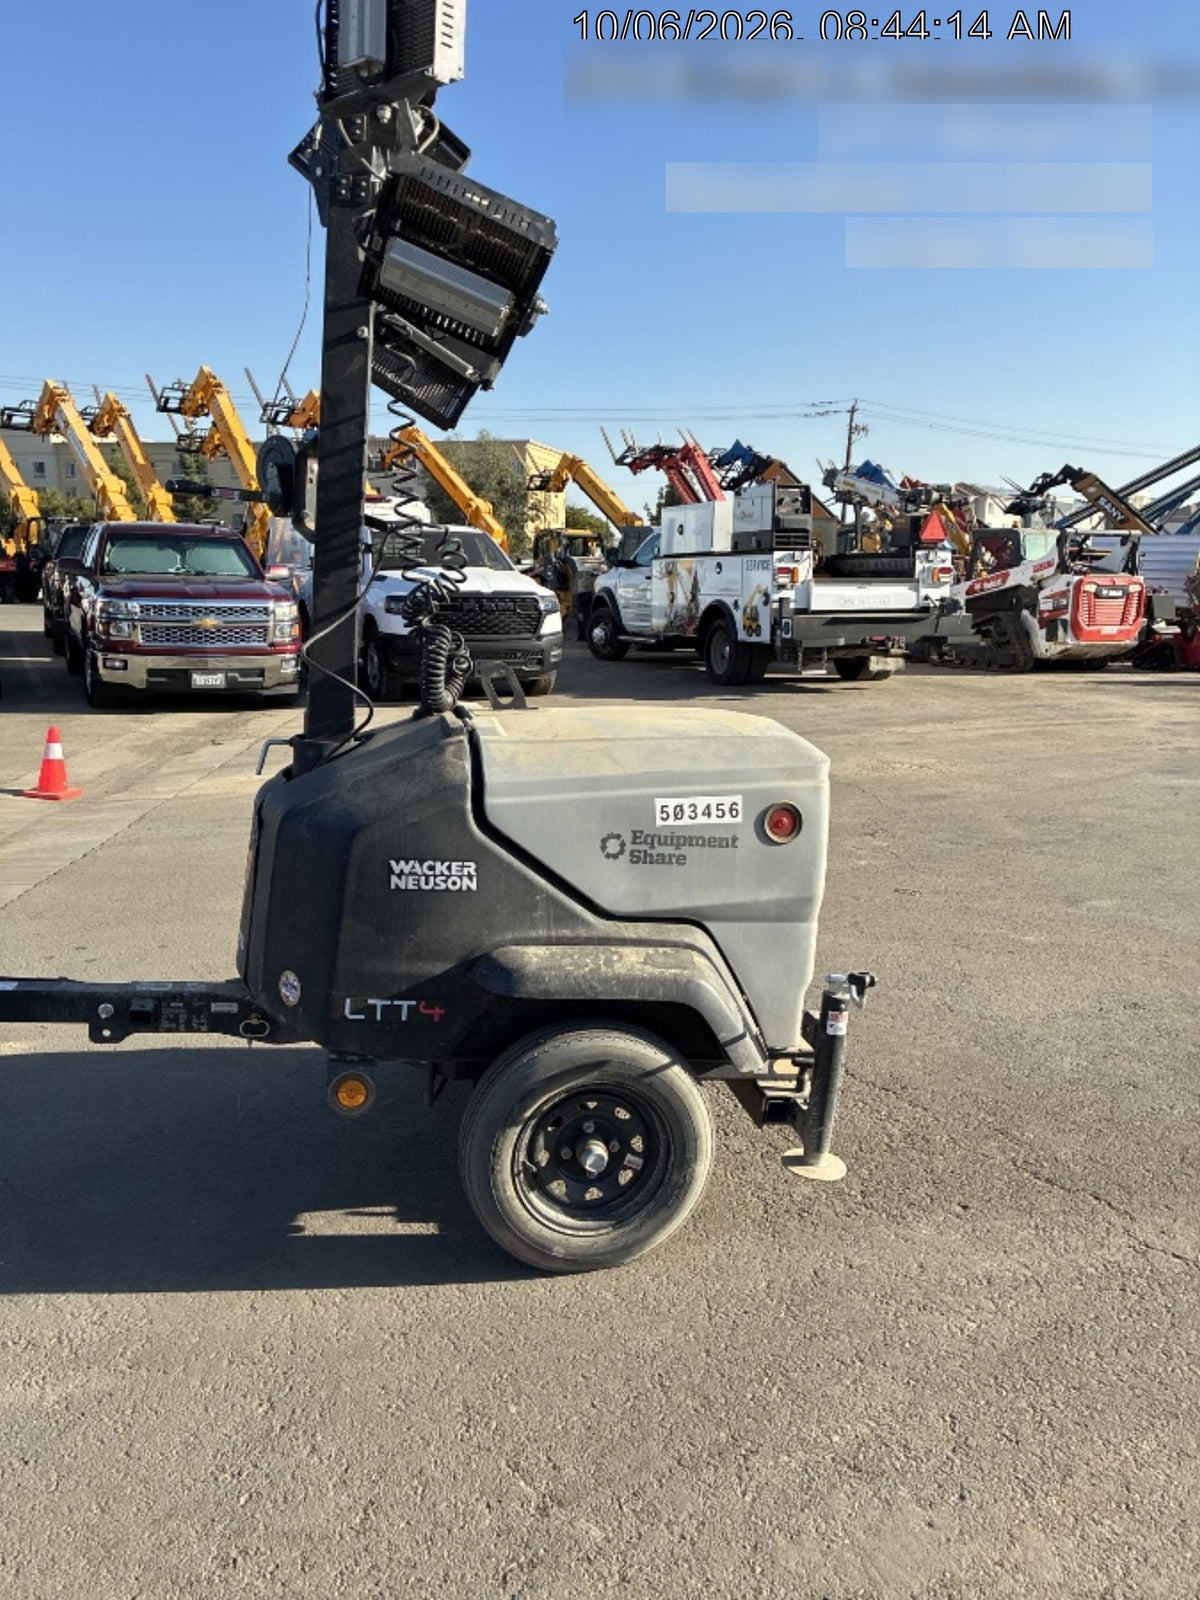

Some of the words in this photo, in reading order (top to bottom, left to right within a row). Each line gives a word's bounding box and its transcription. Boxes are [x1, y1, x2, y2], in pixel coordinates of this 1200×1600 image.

[660, 802, 740, 822] 503456
[630, 829, 739, 851] Equipment
[629, 849, 687, 866] Share
[388, 859, 478, 876] WACKER
[390, 874, 478, 892] NEUSON
[344, 997, 445, 1022] LTT4
